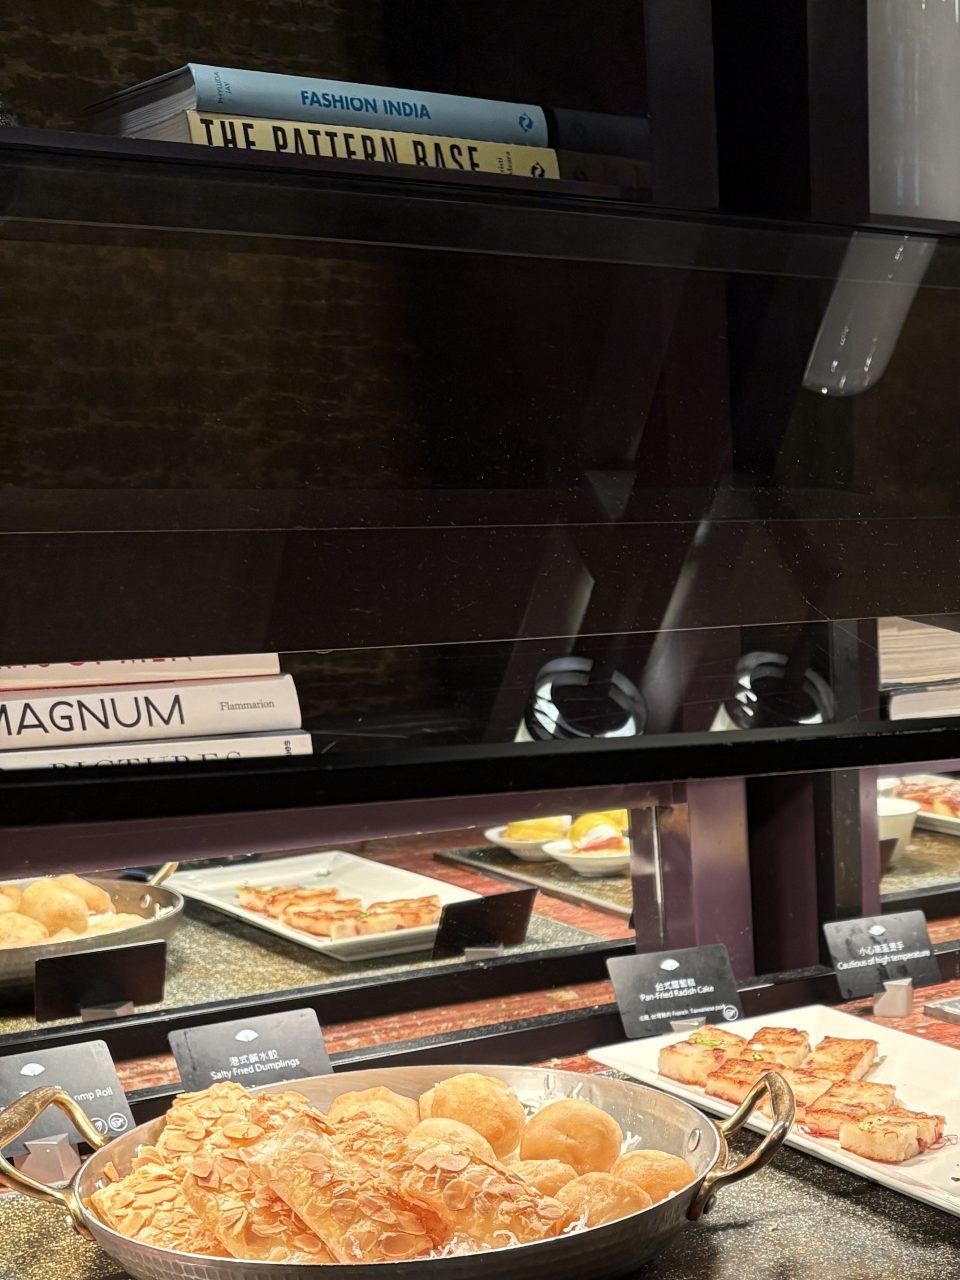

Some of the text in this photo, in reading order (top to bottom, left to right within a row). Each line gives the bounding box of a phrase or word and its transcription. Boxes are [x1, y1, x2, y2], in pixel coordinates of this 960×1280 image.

[300, 90, 431, 120] FASHION INDIA
[200, 119, 480, 172] THE PATTERN BASE
[219, 699, 275, 711] Flammarion
[837, 960, 867, 970] Cautious
[640, 985, 715, 1002] Pan-Fried Radish Cake
[210, 1057, 300, 1081] Salty Fried Dumplings
[73, 1090, 95, 1102] rimp
[95, 1086, 113, 1097] Roll
